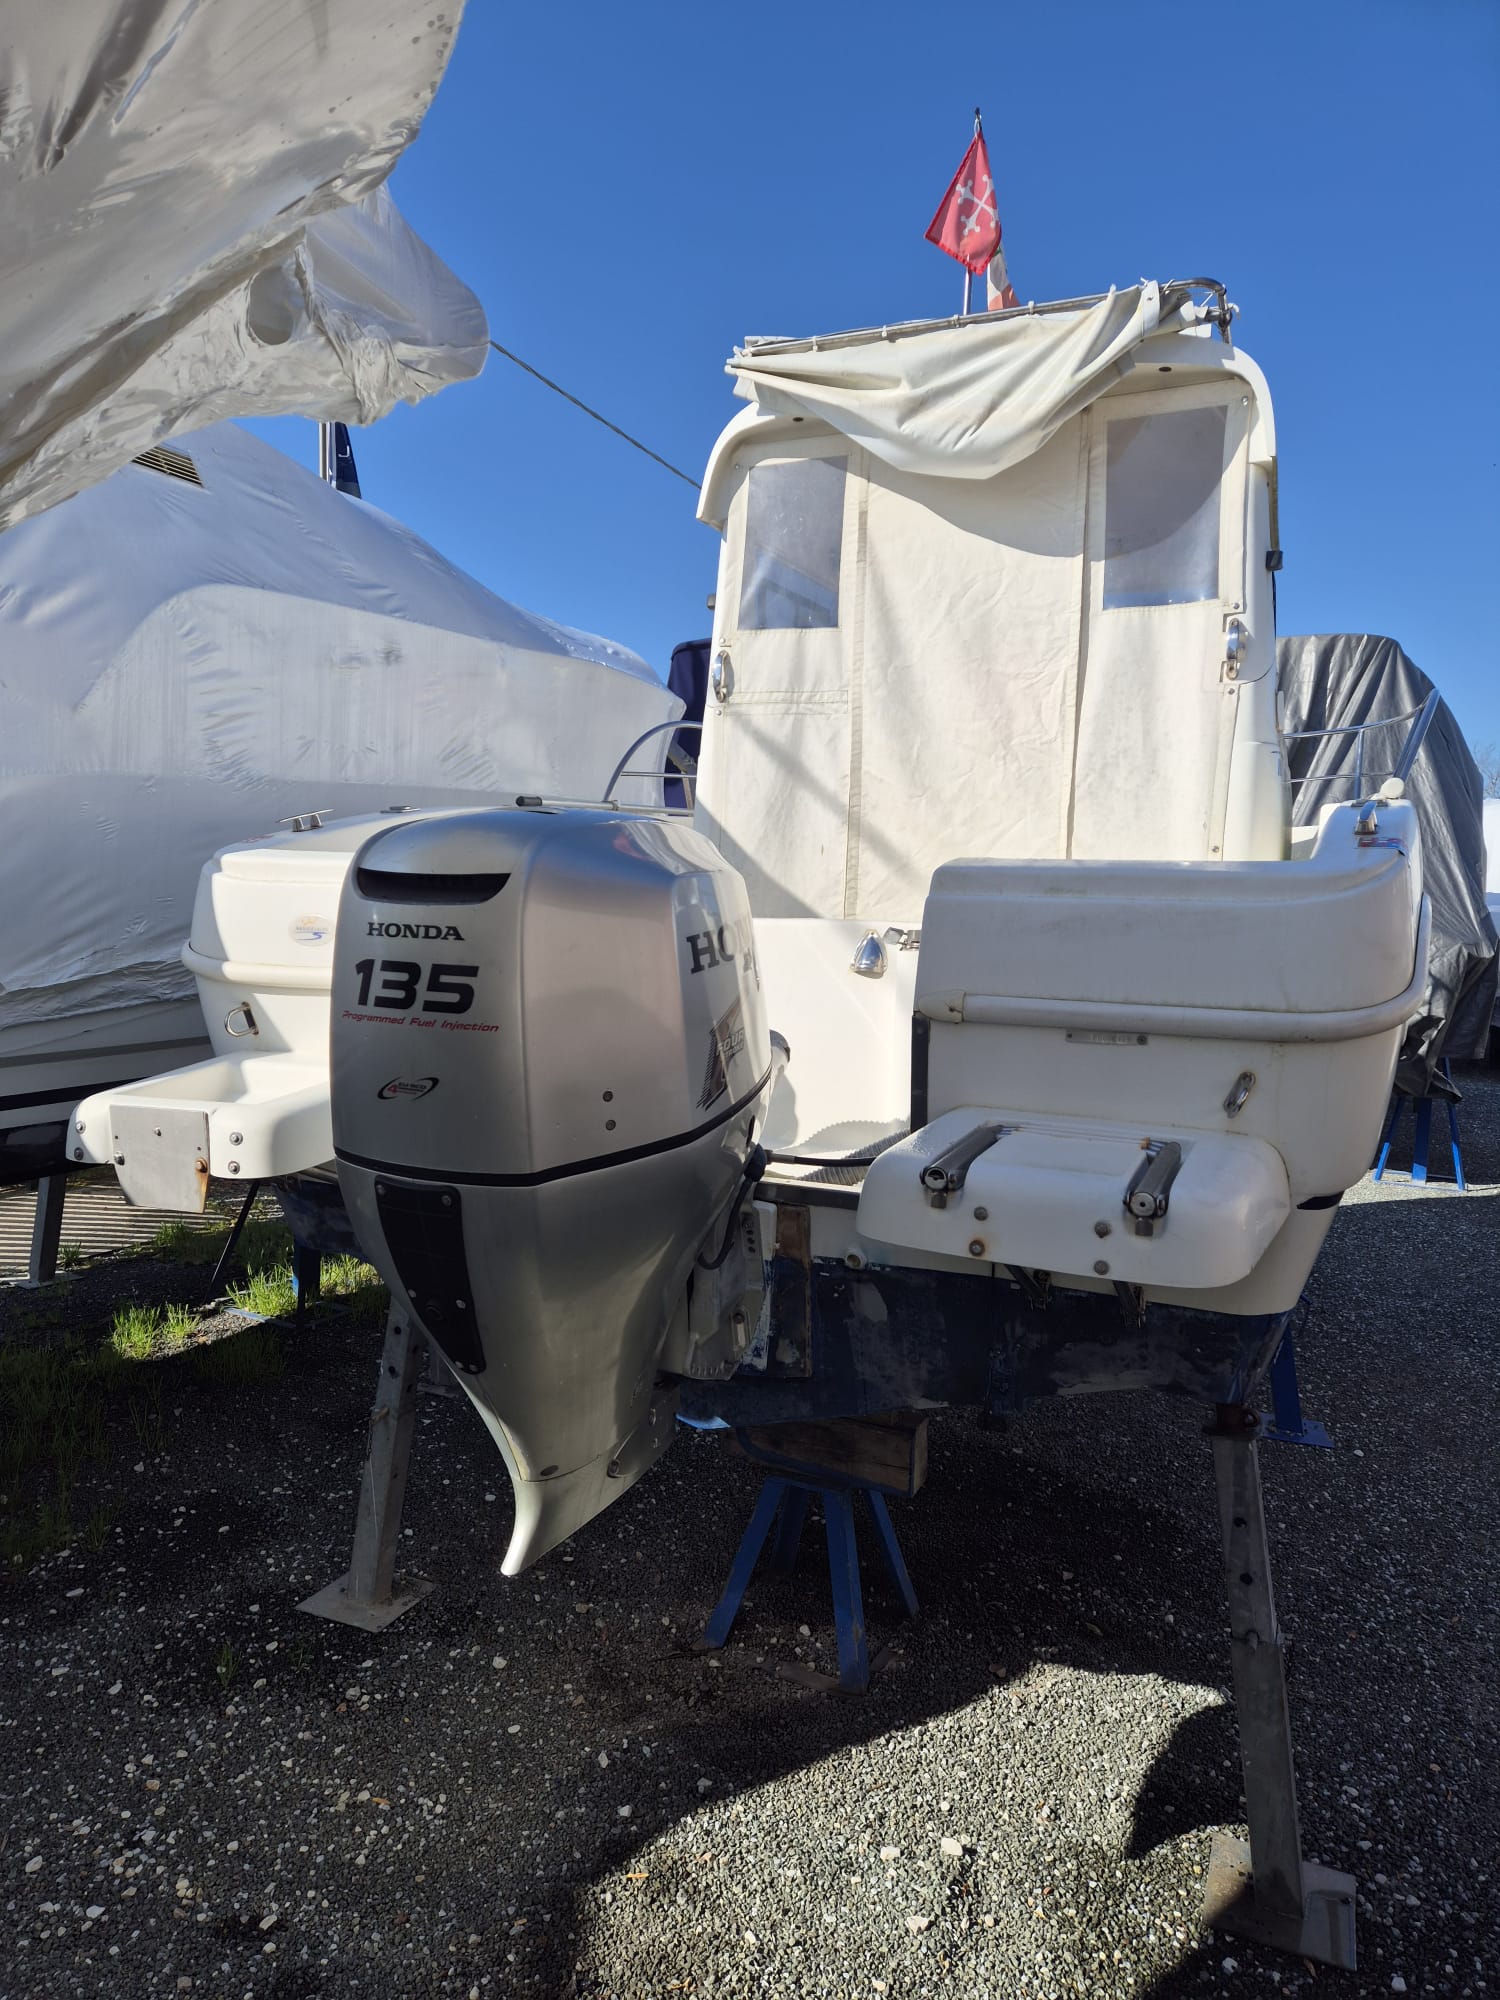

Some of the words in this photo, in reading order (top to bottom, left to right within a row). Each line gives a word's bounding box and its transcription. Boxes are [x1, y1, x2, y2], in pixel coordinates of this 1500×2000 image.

[367, 922, 465, 941] HONDA
[355, 958, 479, 1014] 135
[342, 1010, 405, 1025] Programmed
[410, 1017, 437, 1028] Fuel
[441, 1020, 499, 1032] Injection
[716, 1029, 744, 1056] FOUR
